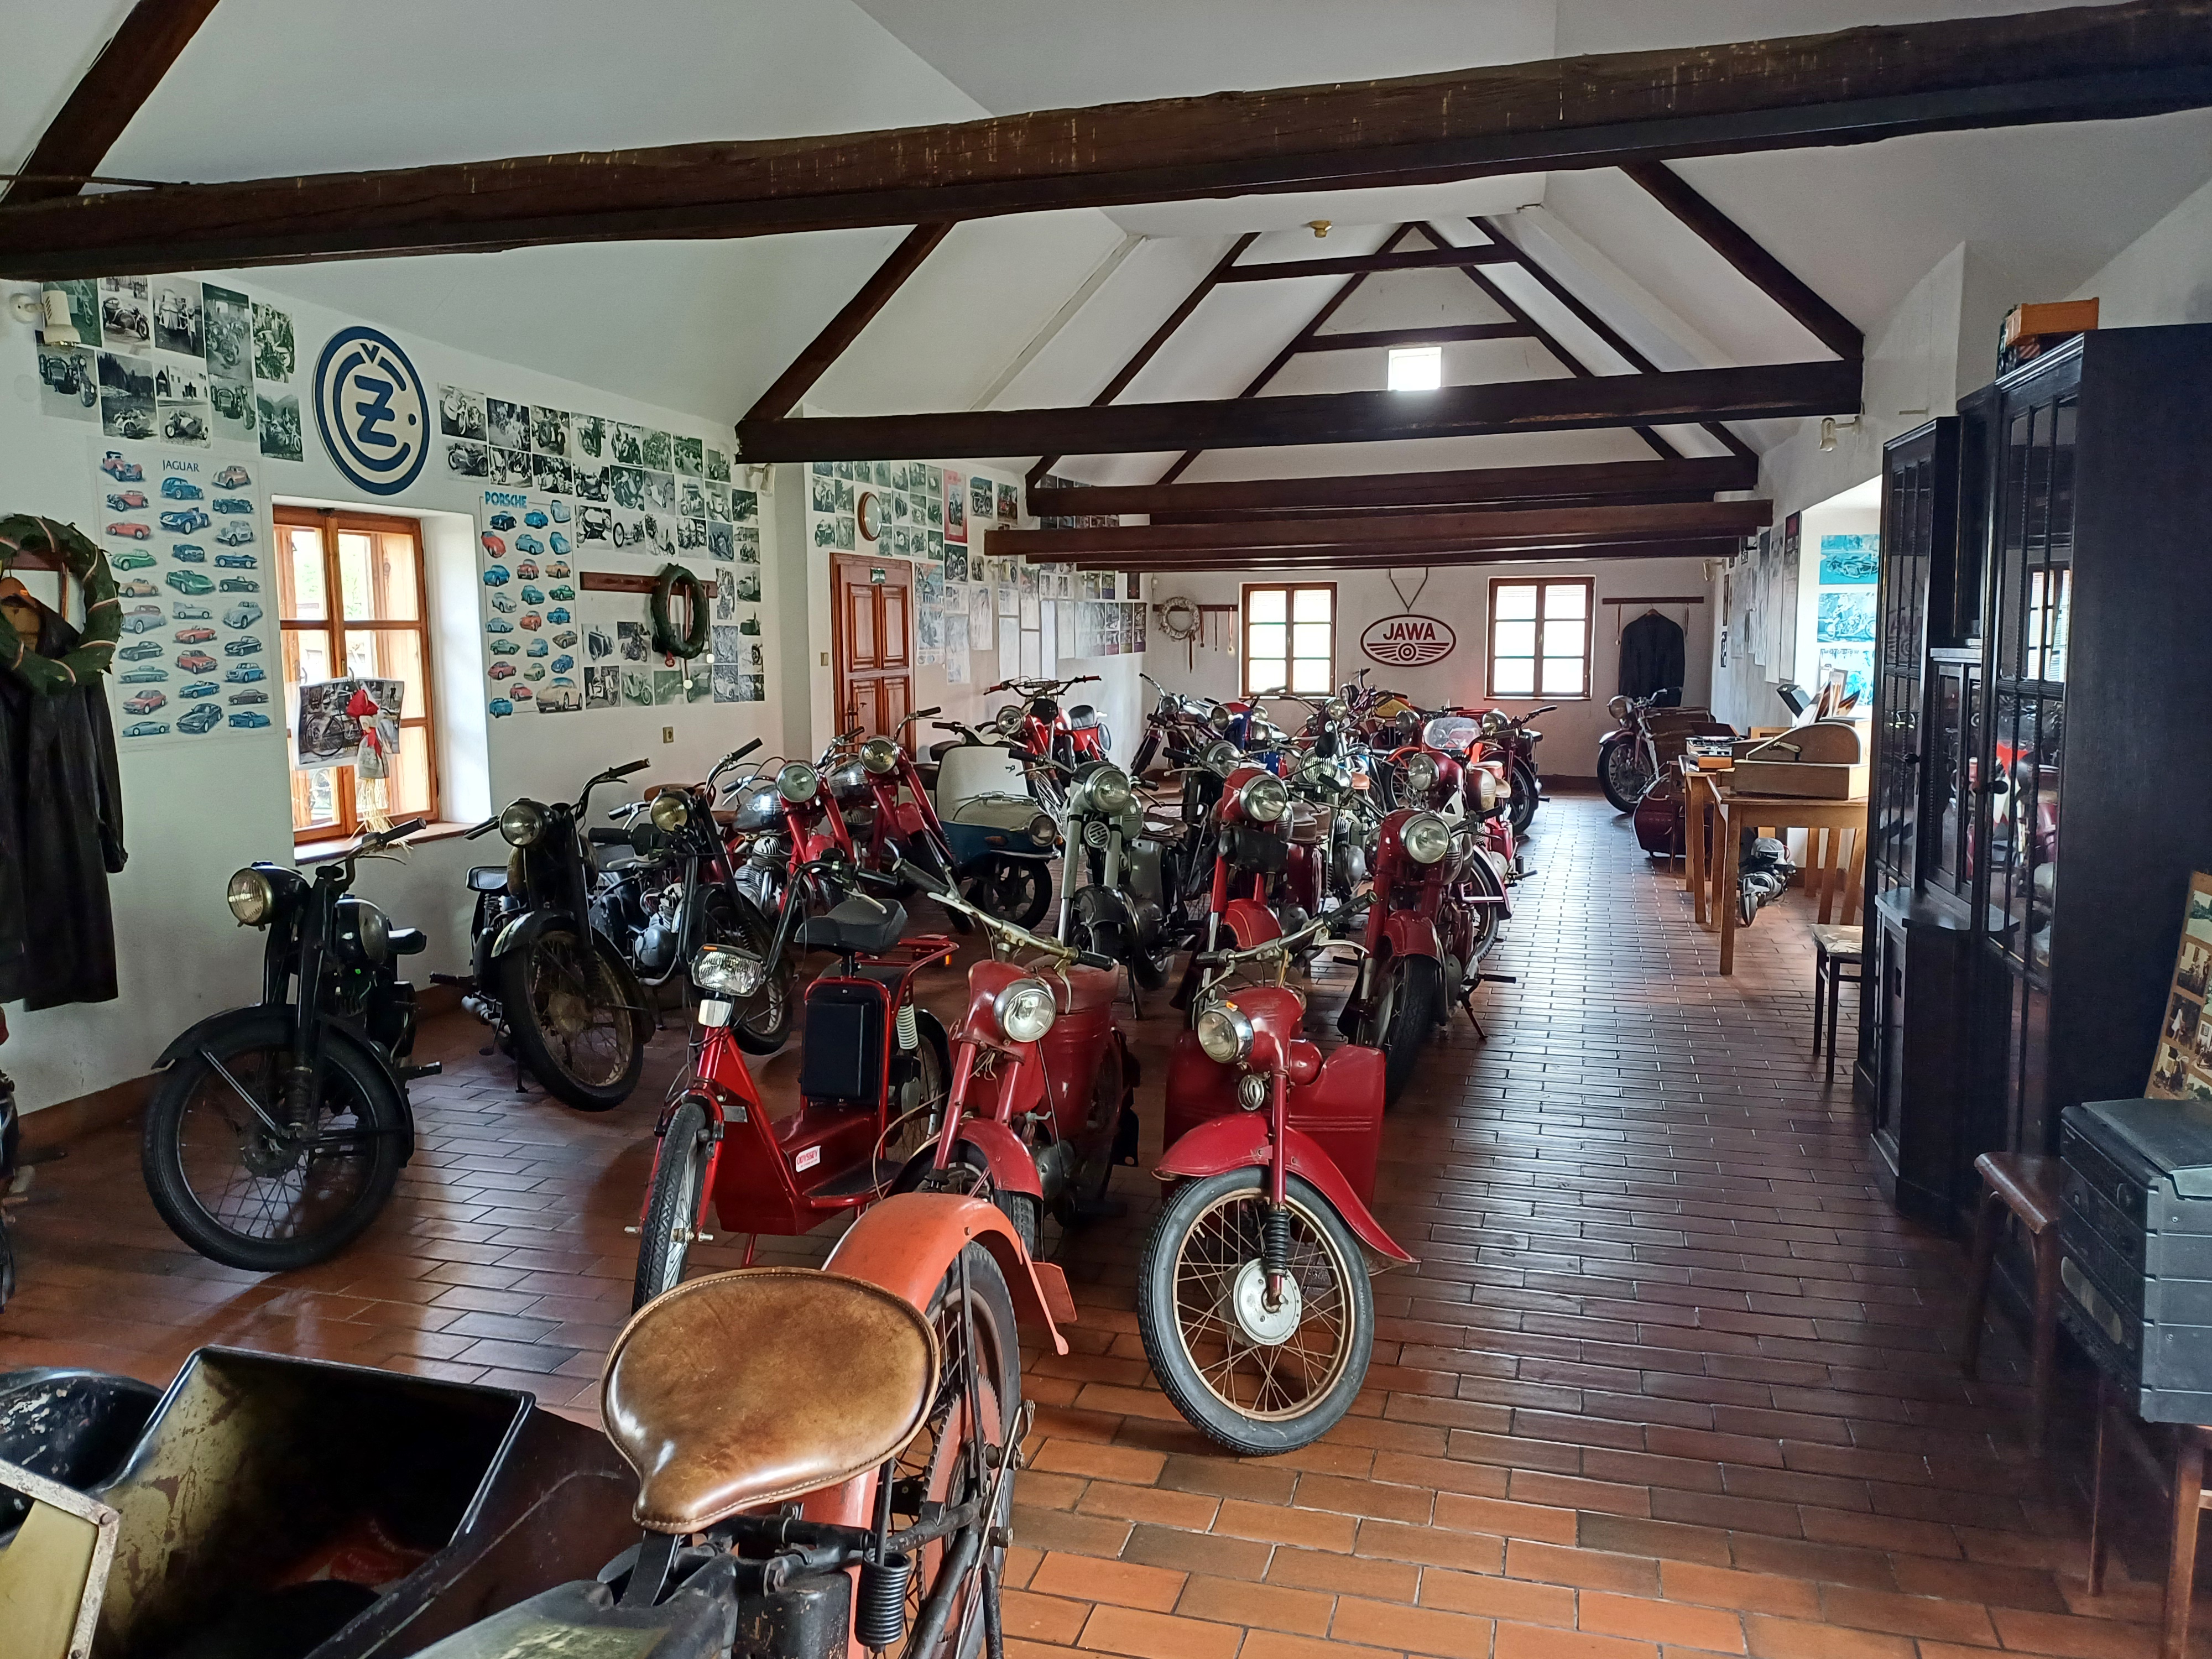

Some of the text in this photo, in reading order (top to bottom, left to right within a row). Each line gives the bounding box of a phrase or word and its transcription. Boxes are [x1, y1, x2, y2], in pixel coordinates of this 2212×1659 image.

[163, 460, 200, 472] JAGUAR
[485, 491, 527, 509] PORSCHE
[1383, 623, 1436, 640] JAWA
[796, 1148, 818, 1165] ODYSSEY
